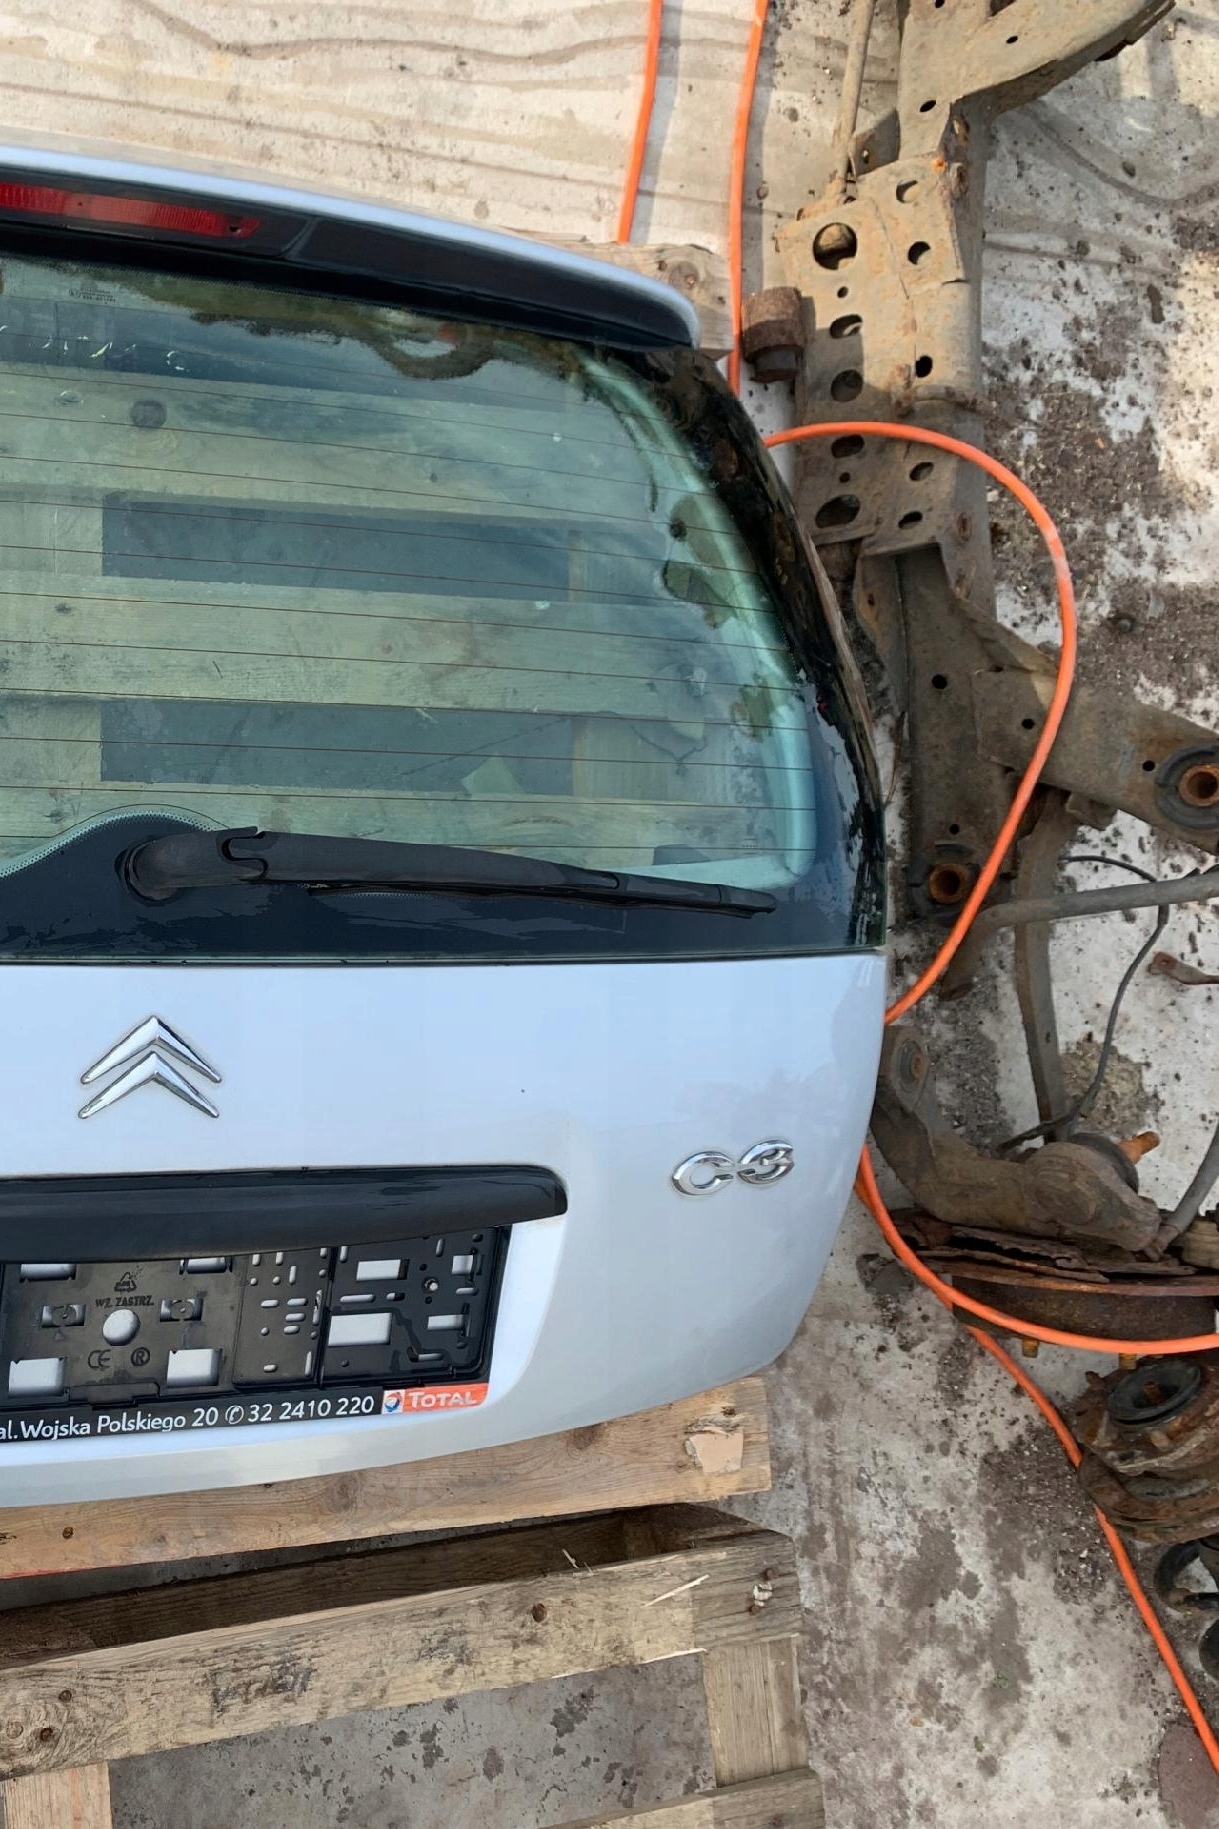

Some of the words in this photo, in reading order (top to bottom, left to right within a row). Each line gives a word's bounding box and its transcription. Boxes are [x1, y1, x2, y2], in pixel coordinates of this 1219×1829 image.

[672, 1139, 795, 1195] C3
[20, 1416, 92, 1441] Wojska
[97, 1410, 186, 1433] Polskiego
[191, 1406, 219, 1427] 20
[247, 1403, 273, 1423] 32
[279, 1399, 332, 1421] 2410
[335, 1395, 375, 1416] 220
[410, 1391, 477, 1408] TOTAL
